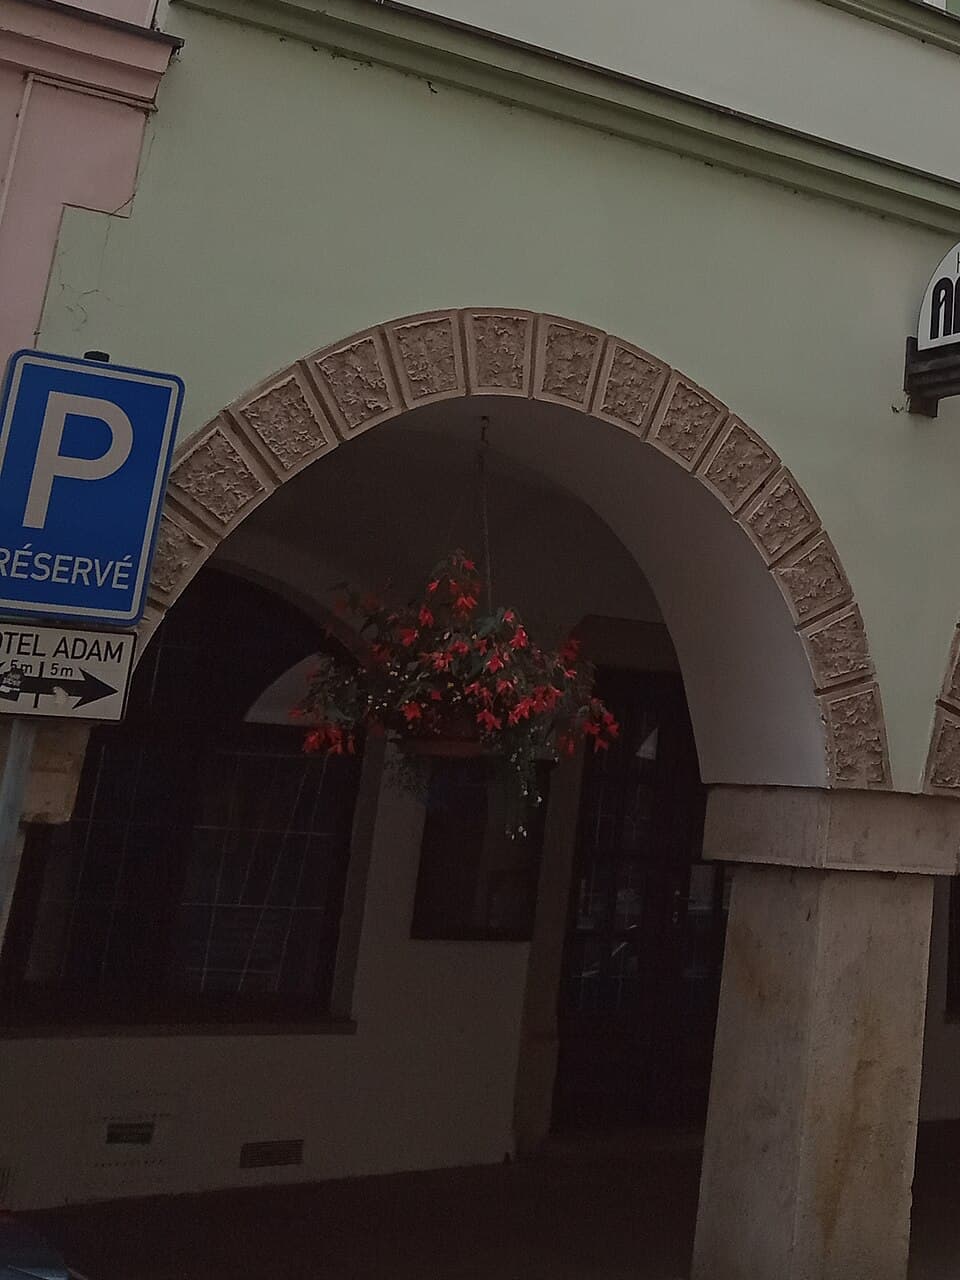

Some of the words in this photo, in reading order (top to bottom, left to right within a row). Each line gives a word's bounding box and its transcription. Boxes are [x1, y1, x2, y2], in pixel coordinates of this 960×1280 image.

[22, 390, 134, 529] P
[0, 543, 133, 590] RÉSERVÉ
[0, 631, 46, 657] TEL
[52, 636, 124, 663] ADAM
